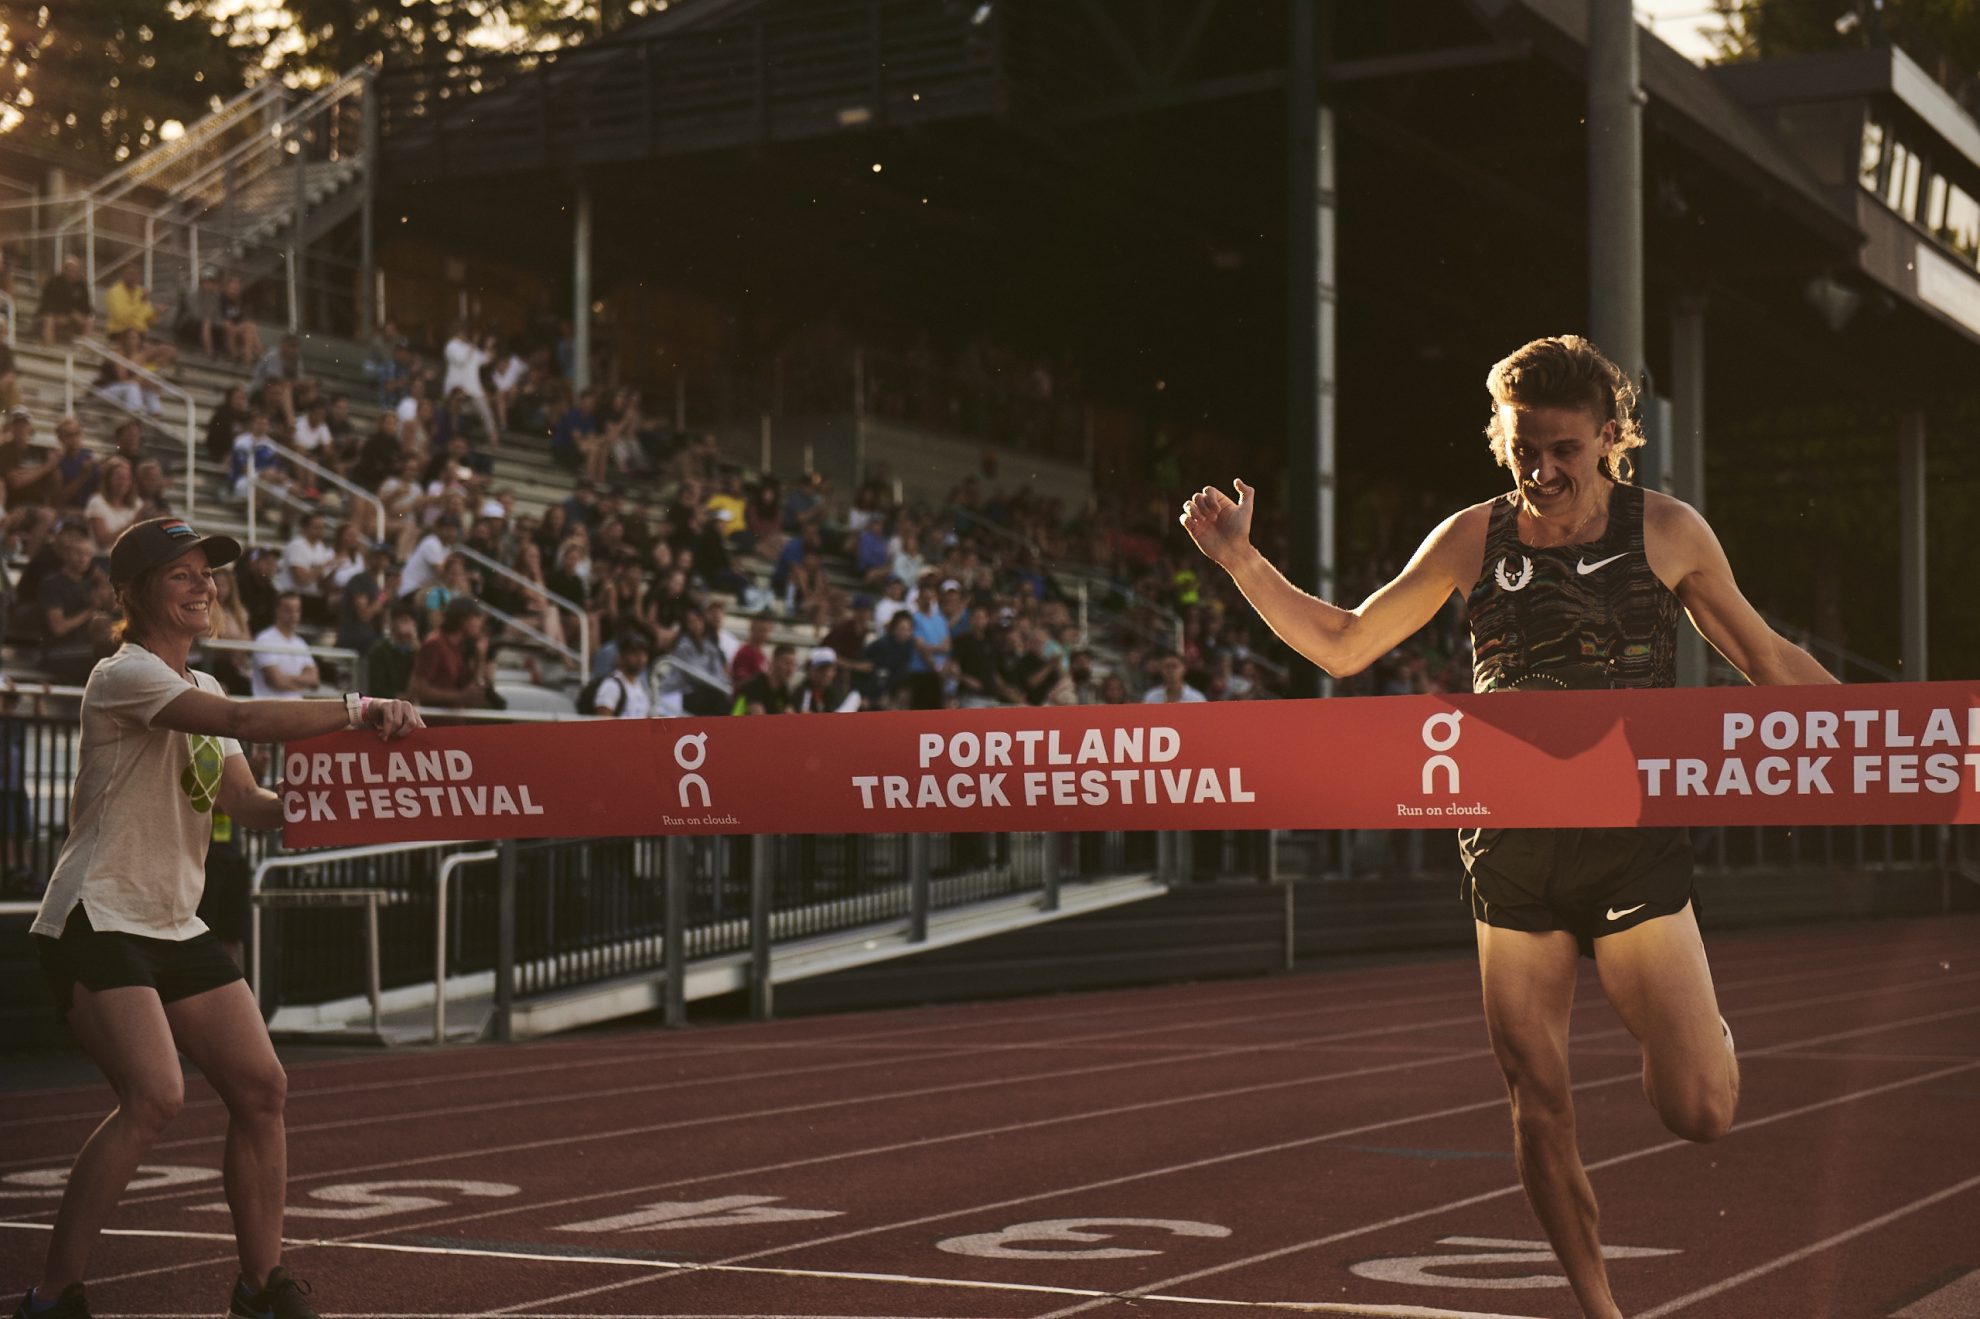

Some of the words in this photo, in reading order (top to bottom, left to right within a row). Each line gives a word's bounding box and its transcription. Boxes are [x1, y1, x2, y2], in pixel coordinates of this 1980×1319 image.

[919, 727, 1181, 768] PORTLAND
[852, 773, 1011, 809] TRACK
[1023, 767, 1256, 807] FESTIVAL
[1637, 756, 1834, 797] TRACK
[345, 785, 545, 820] FESTIVAL
[662, 815, 685, 826] Run
[687, 817, 701, 825] on
[703, 814, 741, 825] clouds.
[1397, 804, 1423, 816] Run
[1426, 806, 1443, 816] on
[1445, 802, 1491, 816] clouds.
